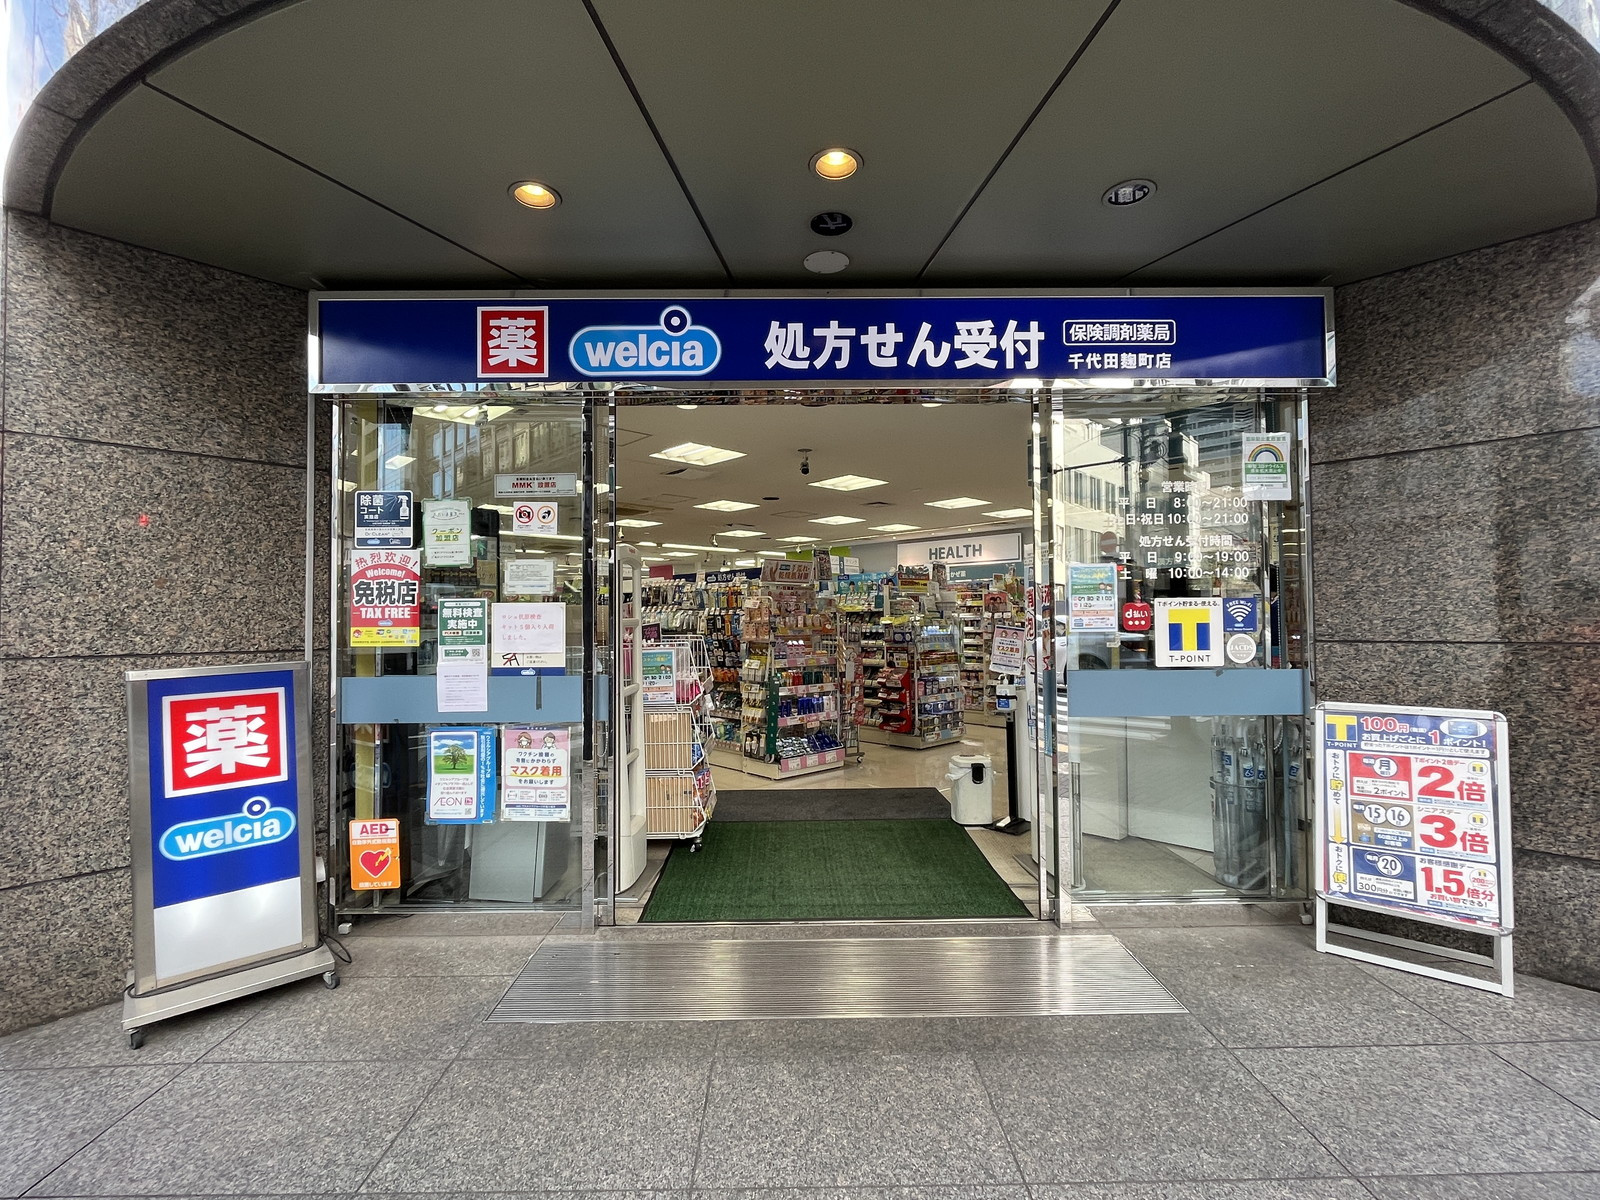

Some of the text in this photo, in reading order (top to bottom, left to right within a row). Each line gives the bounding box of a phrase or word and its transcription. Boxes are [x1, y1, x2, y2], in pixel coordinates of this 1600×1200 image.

[1069, 323, 1171, 342] 保険調剤薬局
[487, 317, 538, 367] 薬
[764, 321, 1045, 370] 処方せん受付
[585, 334, 703, 367] welcia
[1162, 481, 1208, 493] 営業時
[360, 494, 384, 506] 除菌
[1118, 497, 1130, 509] 平
[1146, 498, 1156, 508] 日
[1139, 535, 1233, 547] 処方せん受付時間
[929, 543, 982, 560] HEALTH
[1119, 552, 1132, 563] 平
[1147, 552, 1158, 563] 日
[365, 568, 406, 578] Welcome!
[1119, 568, 1132, 579] 土
[1145, 568, 1158, 579] 曜
[353, 580, 417, 606] 免税店
[360, 607, 411, 619] TAX FREE
[442, 607, 483, 618] 無料検査
[1125, 608, 1148, 619] d払い
[447, 619, 478, 629] 実施中
[1169, 654, 1211, 663] T-POINT
[1361, 717, 1409, 733] 100円
[183, 704, 271, 779] 薬
[510, 766, 562, 777] マスク着用
[1373, 787, 1407, 797] 2ポイント
[1367, 807, 1381, 819] 15
[1391, 808, 1405, 821] 16
[175, 816, 281, 854] welcia
[360, 823, 389, 835] AED
[1381, 857, 1397, 871] 20
